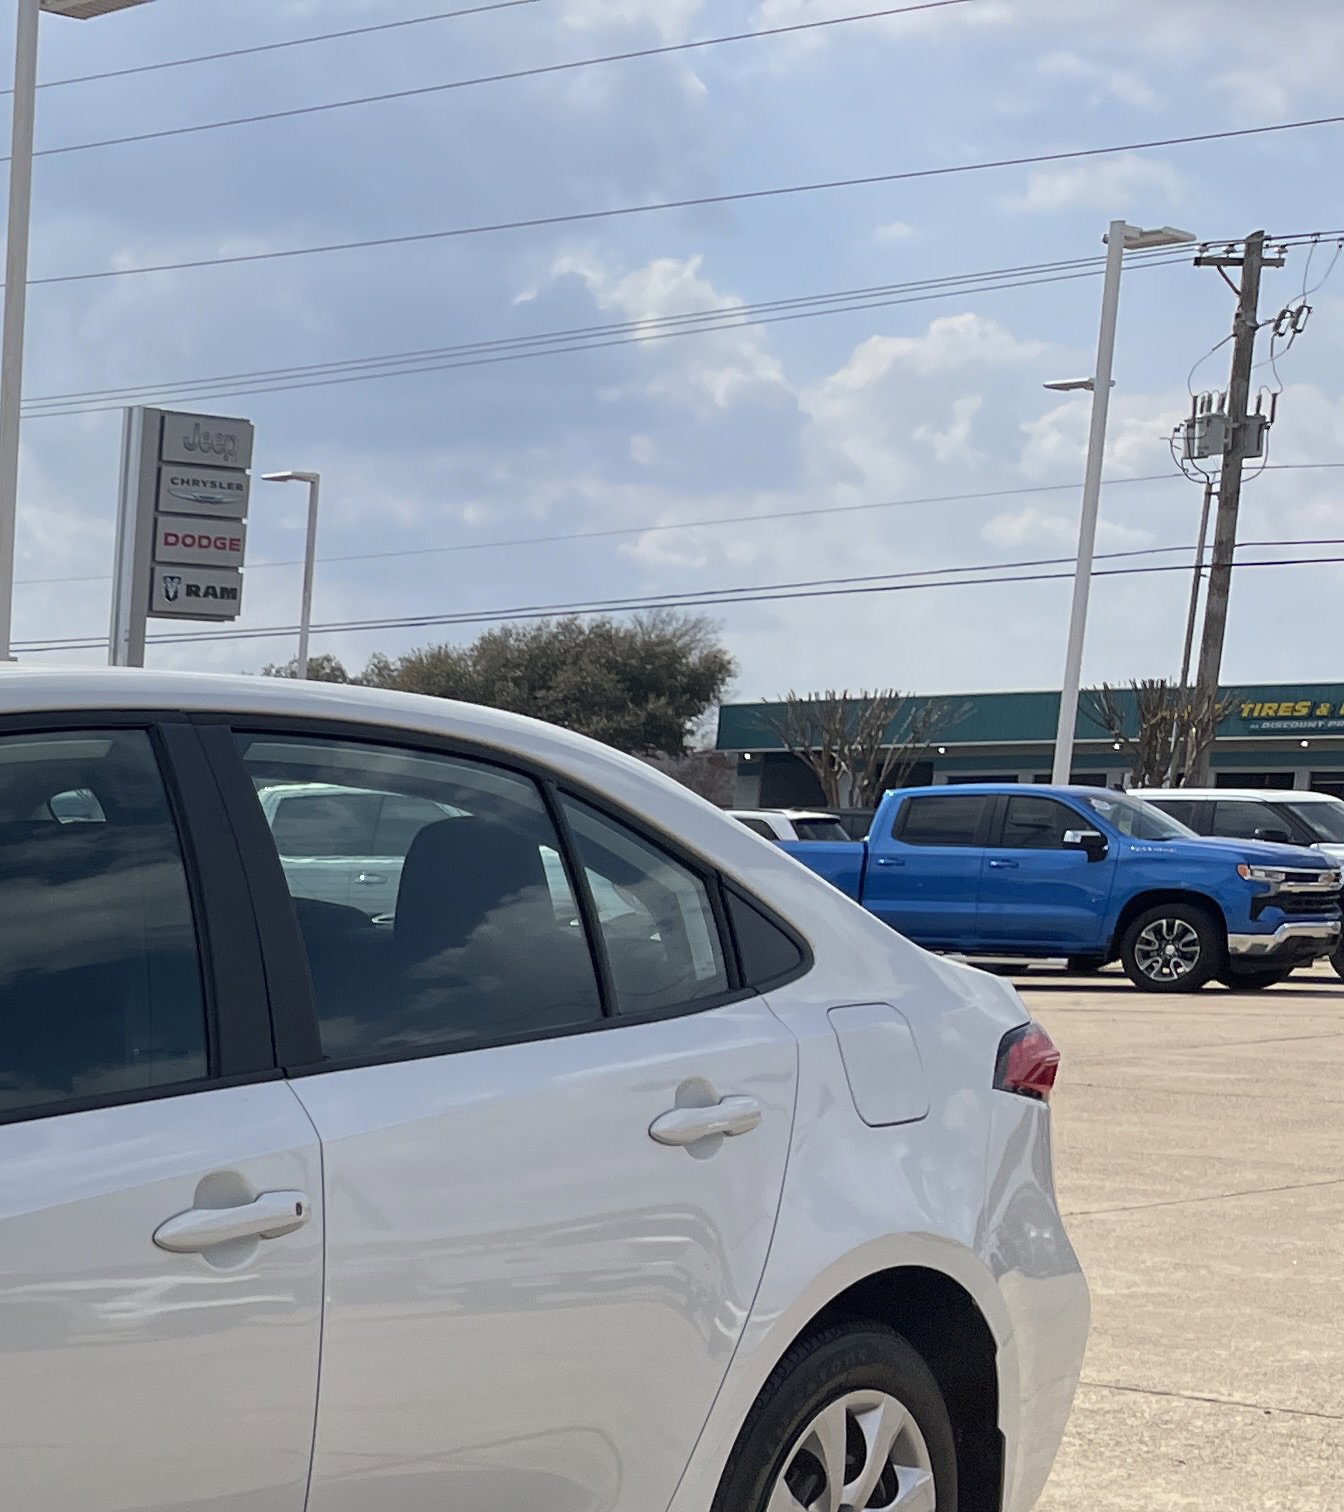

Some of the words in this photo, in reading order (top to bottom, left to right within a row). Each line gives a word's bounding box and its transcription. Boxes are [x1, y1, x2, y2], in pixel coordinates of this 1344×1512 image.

[181, 422, 239, 462] Jeep
[170, 476, 244, 492] CHRYSLER
[163, 532, 241, 552] DODGE
[185, 584, 238, 600] RAM
[1240, 701, 1311, 718] TIRES
[1261, 720, 1325, 730] DISCOUNT
